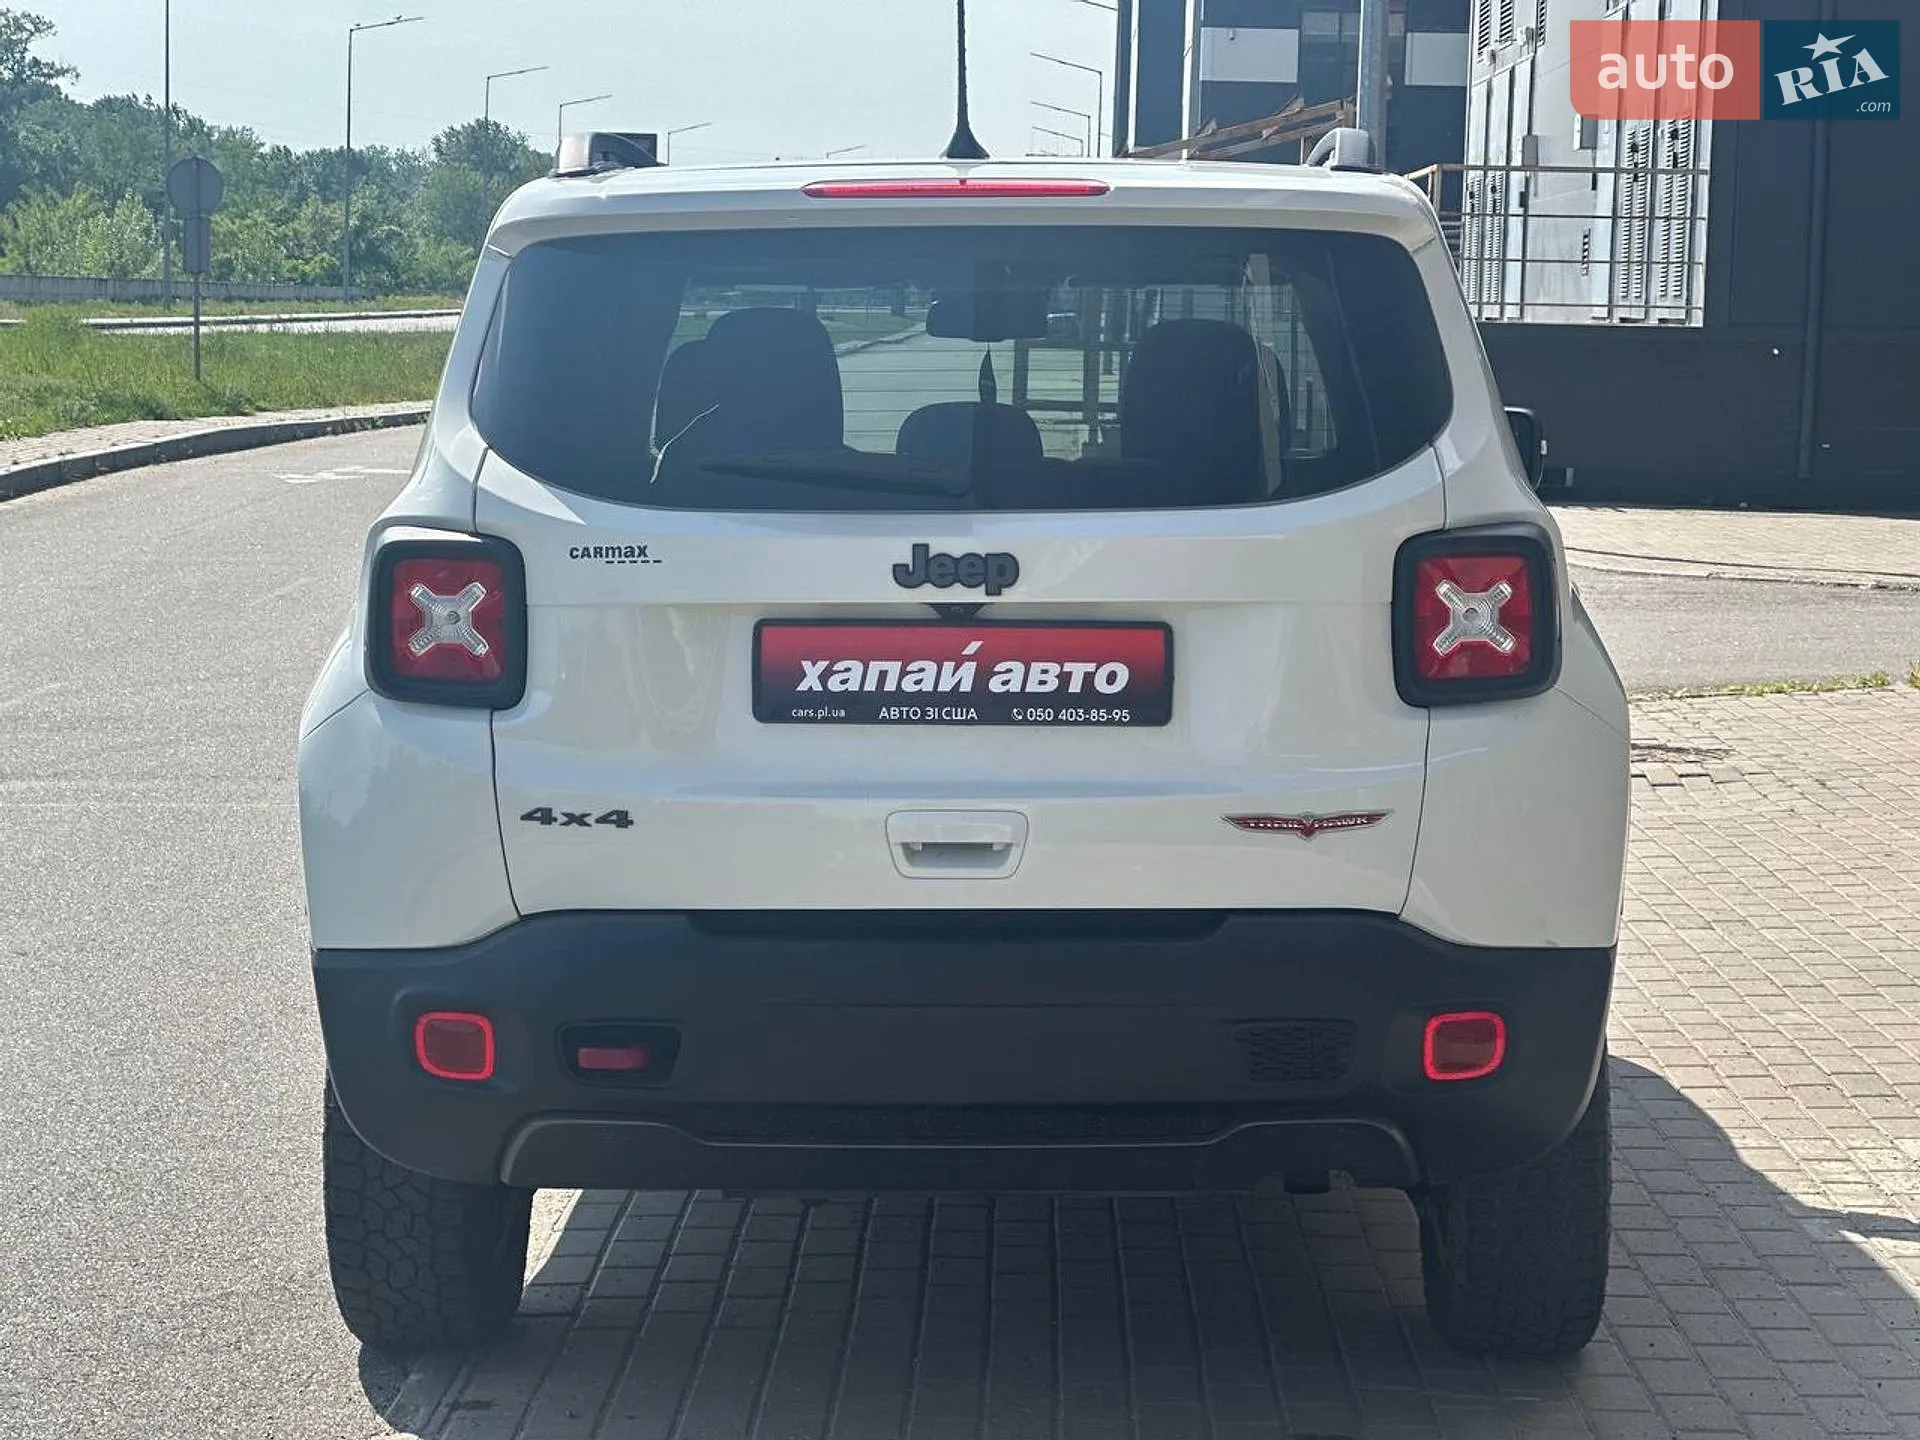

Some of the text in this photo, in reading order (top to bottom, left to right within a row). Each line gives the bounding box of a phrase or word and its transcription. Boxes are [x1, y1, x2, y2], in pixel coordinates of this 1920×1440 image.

[892, 543, 1020, 597] Jeep
[987, 659, 1131, 694] авто
[791, 706, 846, 720] cars.pl.ua
[878, 706, 922, 720] АВТО
[941, 707, 979, 720] США
[1026, 707, 1131, 722] 050 403-85-95
[519, 806, 634, 829] 4x4
